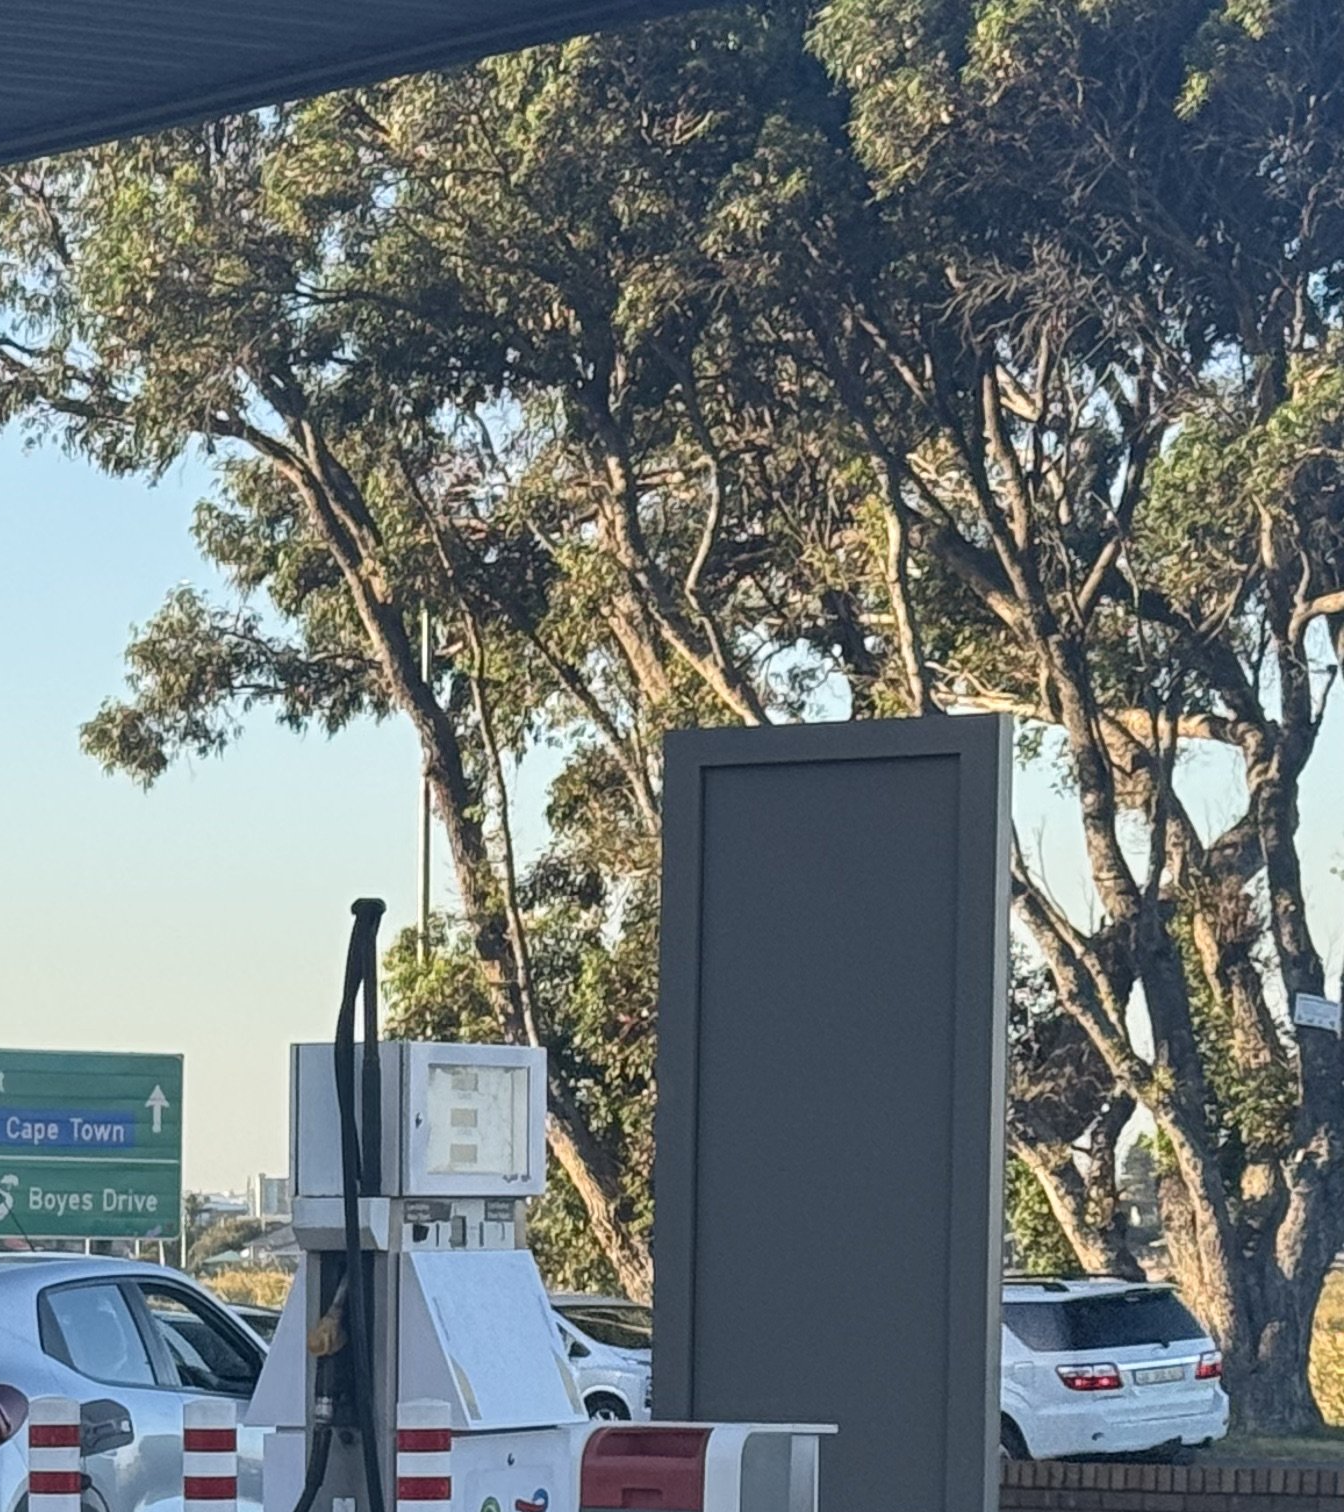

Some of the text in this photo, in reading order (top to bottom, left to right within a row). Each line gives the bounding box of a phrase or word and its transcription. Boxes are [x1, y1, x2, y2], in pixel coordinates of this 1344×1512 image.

[6, 1116, 59, 1145] Cape
[69, 1117, 125, 1143] Town
[29, 1186, 93, 1217] Boyes
[102, 1188, 158, 1212] Drive
